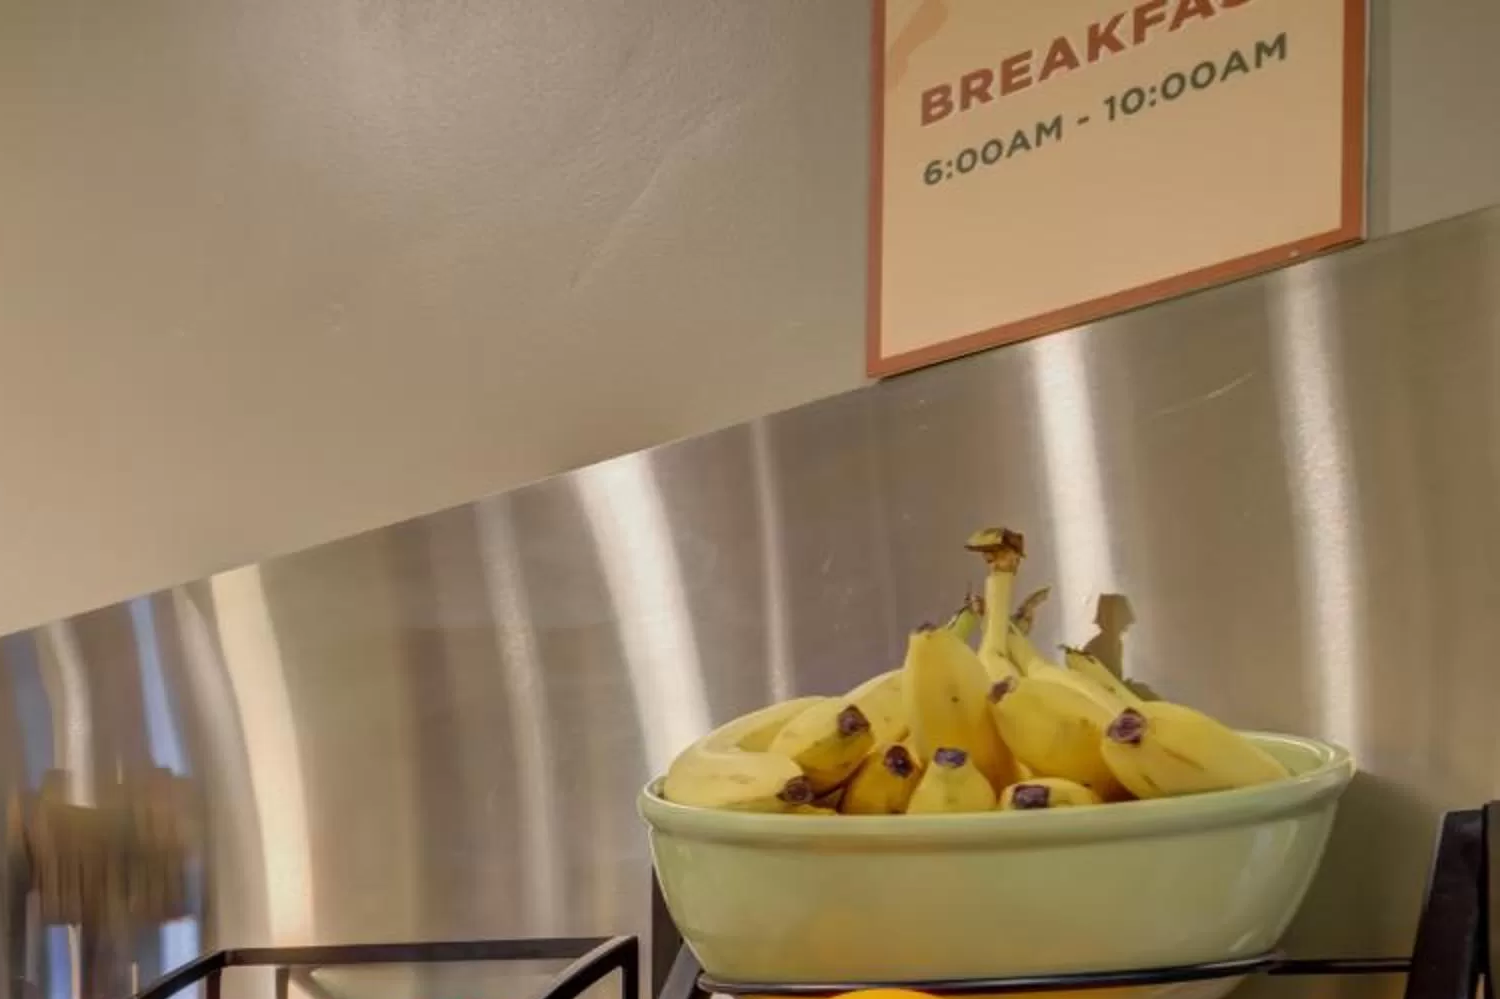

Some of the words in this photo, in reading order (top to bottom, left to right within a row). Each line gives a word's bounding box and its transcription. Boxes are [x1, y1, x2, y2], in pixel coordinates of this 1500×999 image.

[920, 0, 1252, 127] BREAKFA
[923, 115, 1062, 186] 6:00AM
[1104, 31, 1287, 121] 10:00AM
